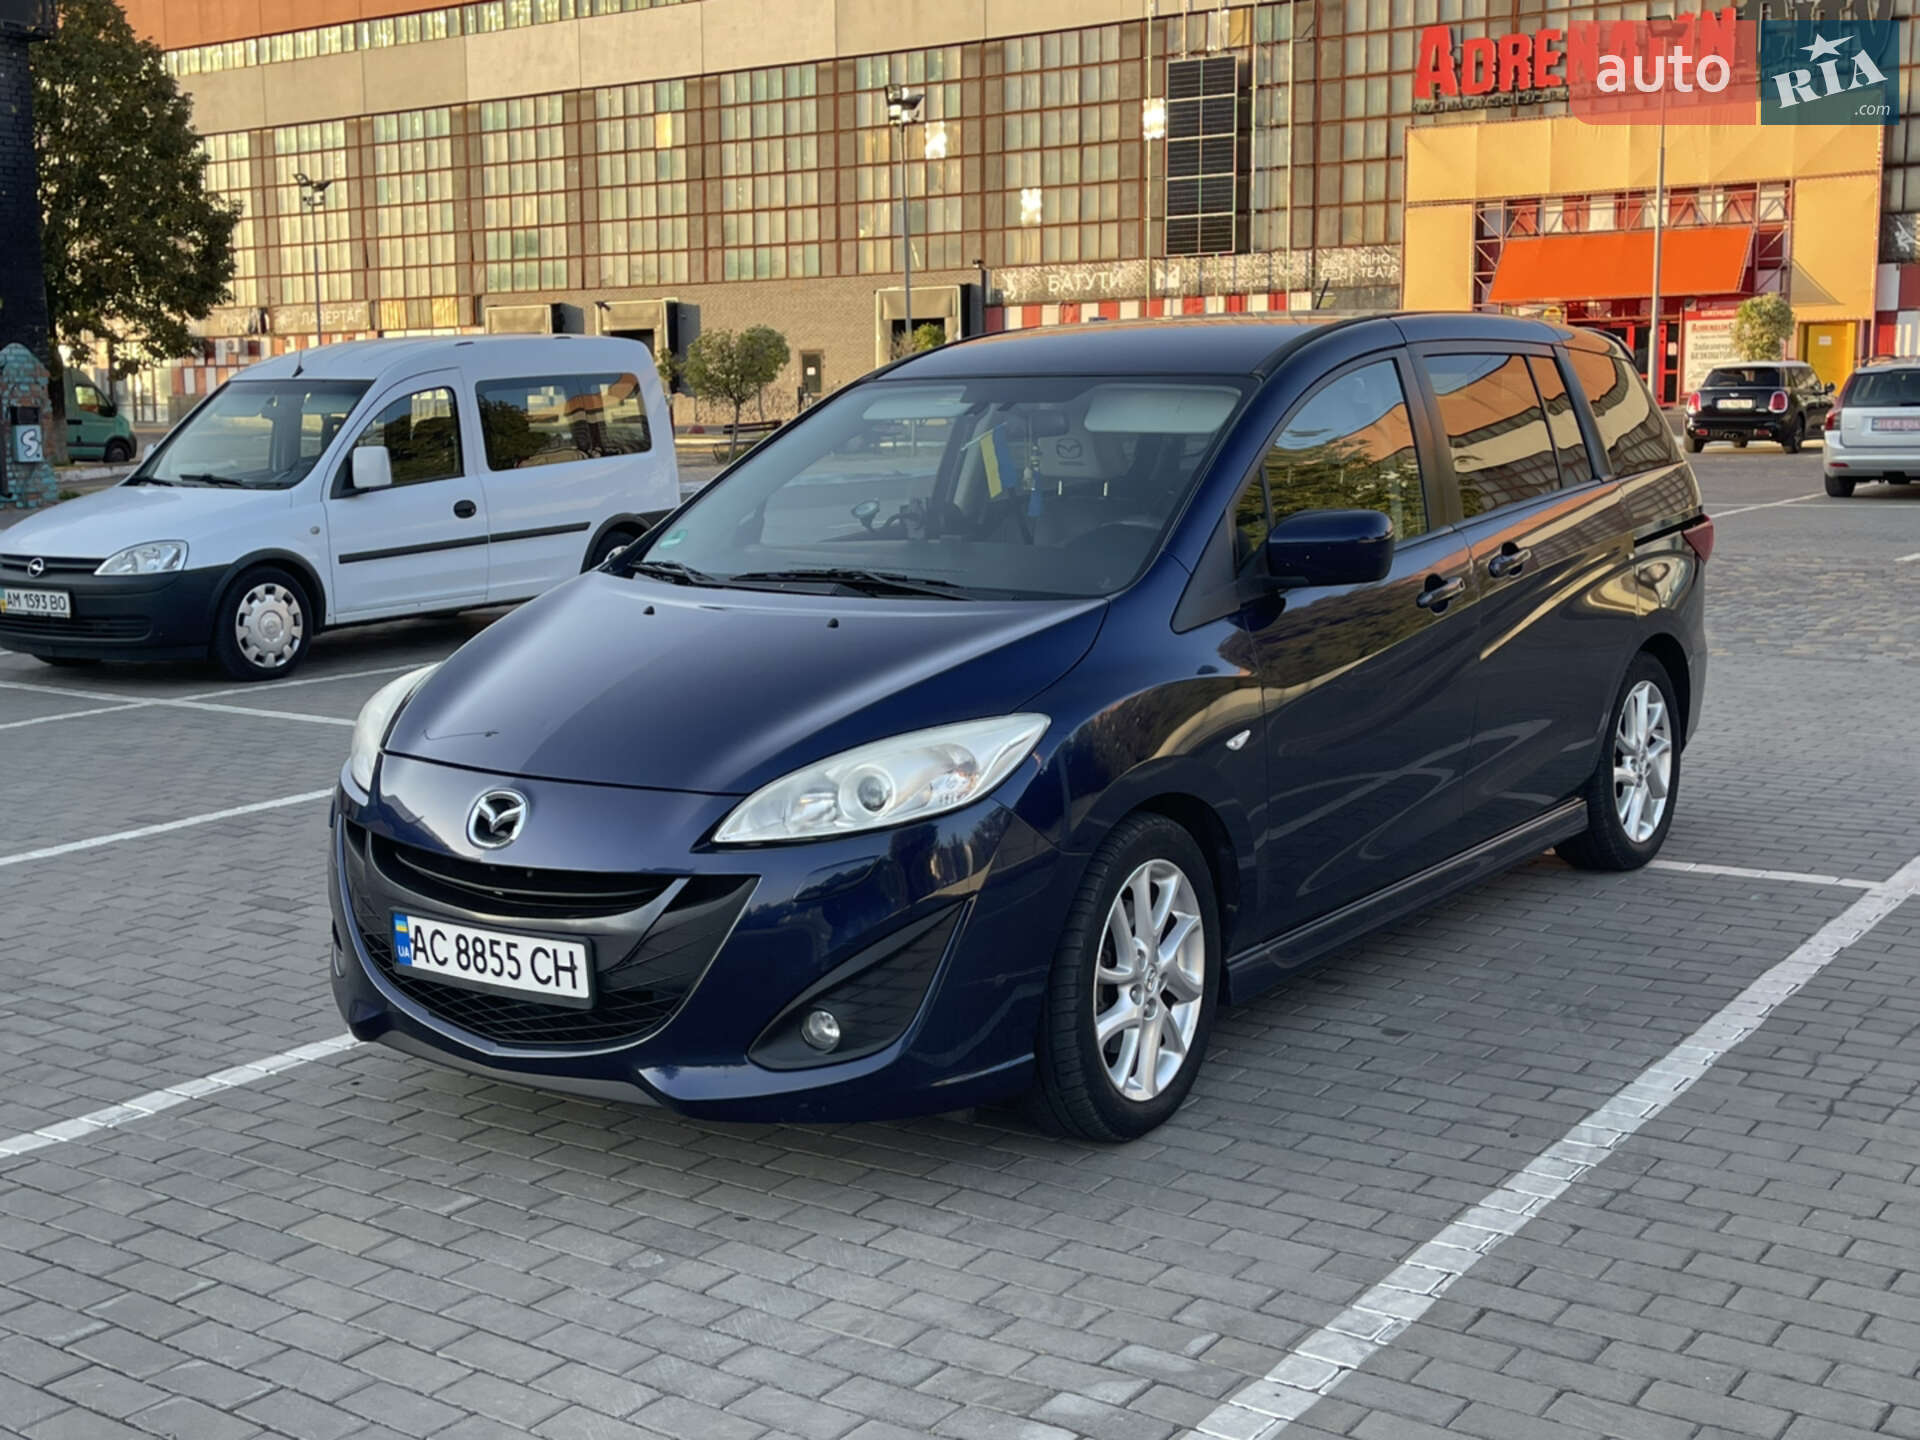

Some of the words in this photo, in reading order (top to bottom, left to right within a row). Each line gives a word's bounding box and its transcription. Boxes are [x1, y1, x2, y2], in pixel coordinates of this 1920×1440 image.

[1048, 271, 1122, 293] БАТУТИ
[1360, 265, 1399, 279] ТЕАТР
[7, 591, 21, 608] AM
[24, 593, 48, 610] 1593
[50, 594, 67, 611] BO
[398, 945, 411, 958] UA
[412, 925, 448, 967] AC
[456, 933, 521, 981] 8855
[530, 946, 577, 990] CH
